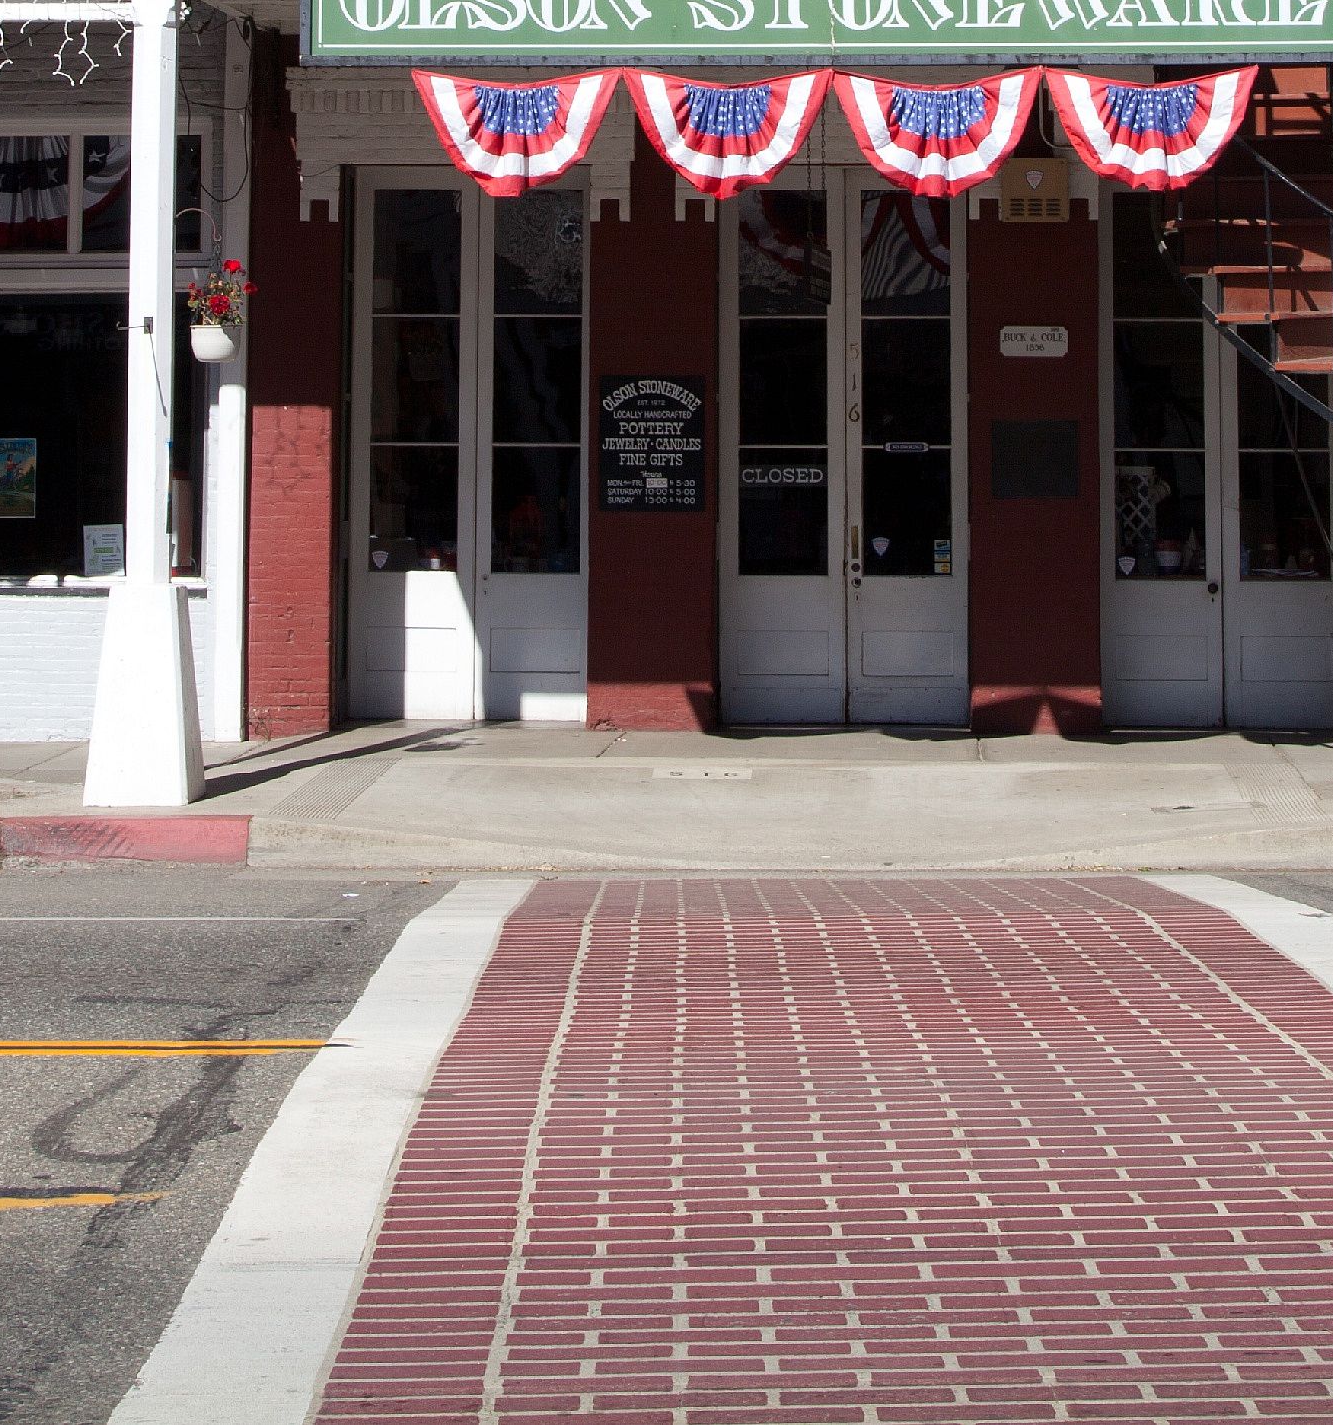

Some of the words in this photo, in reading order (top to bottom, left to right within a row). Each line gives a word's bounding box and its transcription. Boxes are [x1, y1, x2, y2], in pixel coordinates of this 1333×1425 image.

[1003, 332, 1026, 342] BUCK
[1041, 332, 1064, 342] COLE
[602, 382, 639, 411] OLSON
[637, 379, 702, 412] STONEWARE
[613, 410, 643, 419] LOCALLY
[644, 410, 692, 419] HANDCRAFTED
[618, 421, 684, 435] POTTERY
[602, 437, 651, 450] JEWELRY
[655, 437, 701, 451] CANDLES
[618, 453, 647, 466] FINE
[649, 453, 683, 466] GIFTS
[741, 468, 824, 484] CLOSED
[607, 488, 643, 496] SATURDAY
[607, 496, 635, 504] SUNDAY
